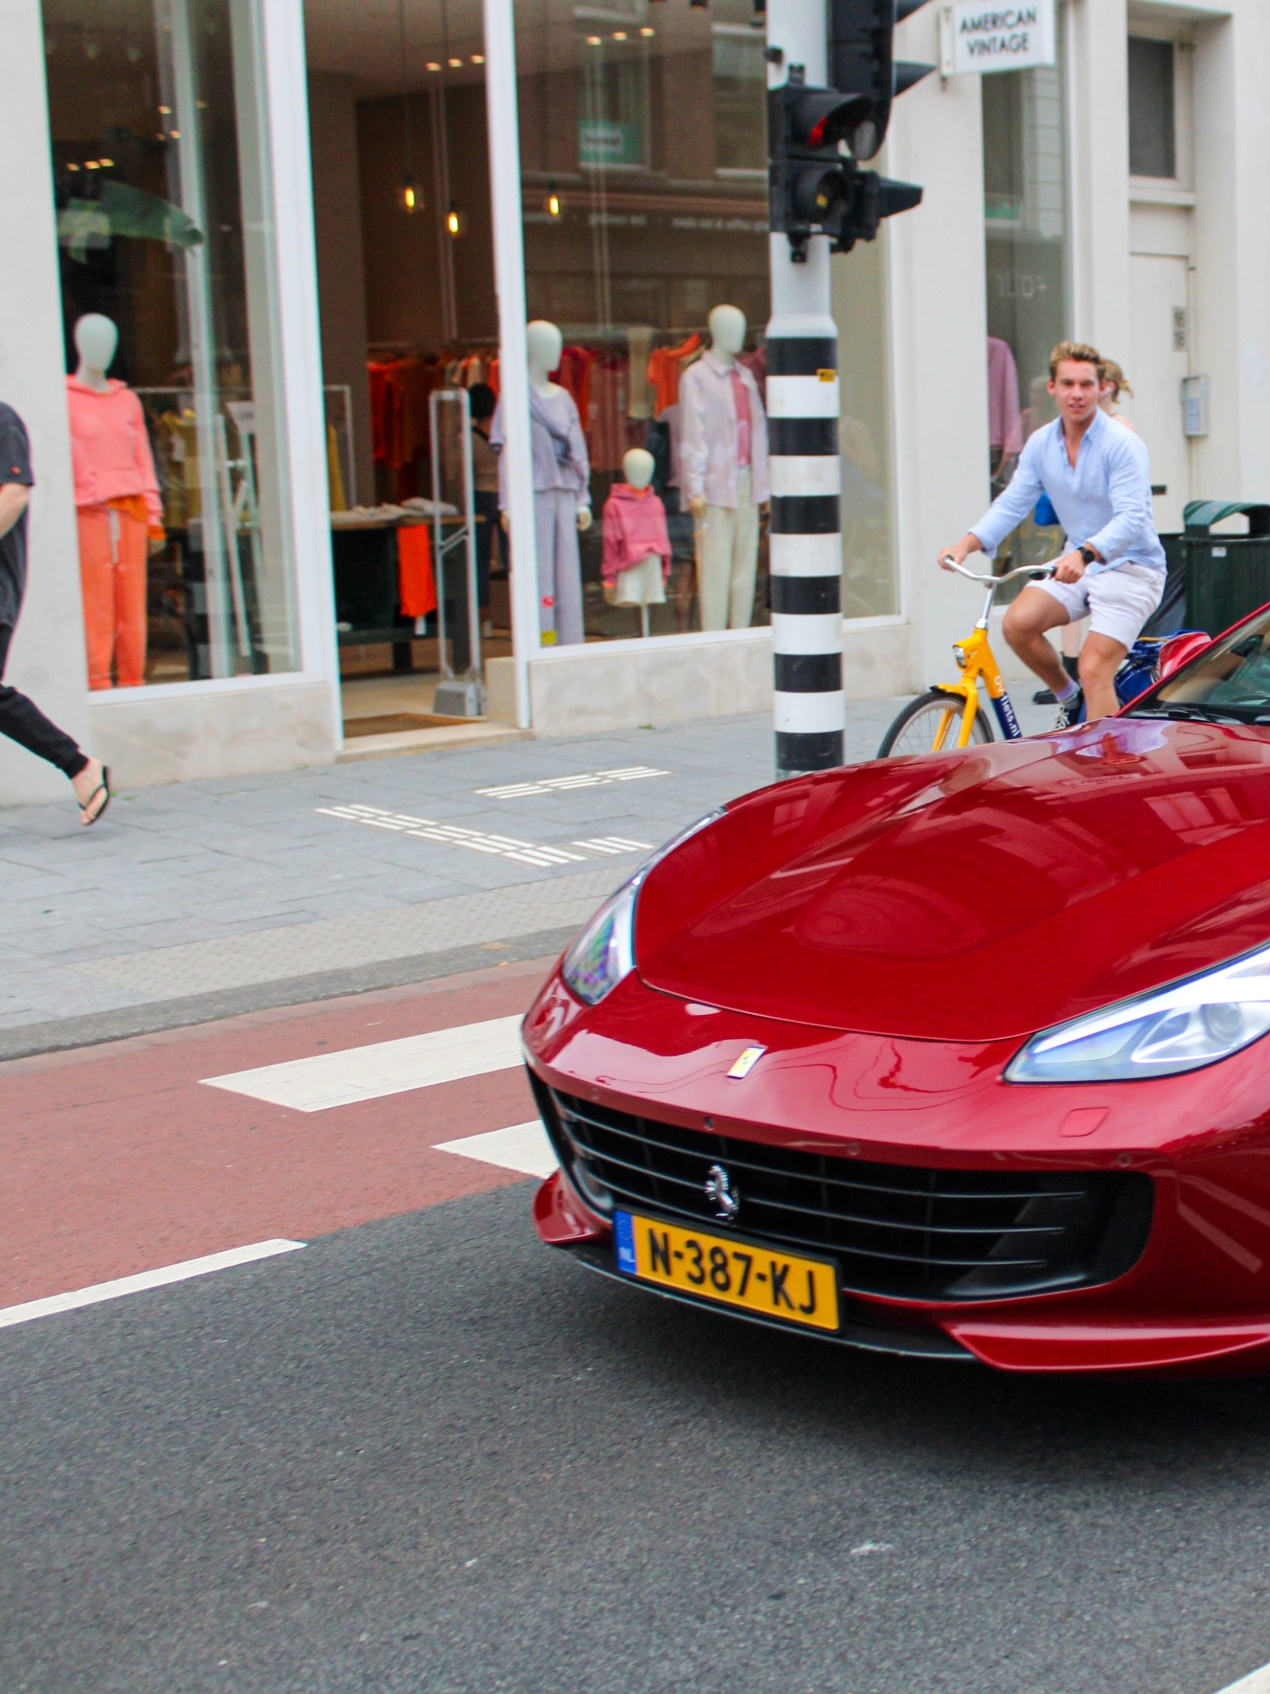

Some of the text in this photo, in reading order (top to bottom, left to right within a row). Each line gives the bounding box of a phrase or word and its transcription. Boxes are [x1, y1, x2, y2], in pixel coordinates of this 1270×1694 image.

[959, 6, 1037, 33] AMERICAN
[966, 31, 1029, 56] VINTAGE
[648, 1227, 816, 1315] N-387-KJ
